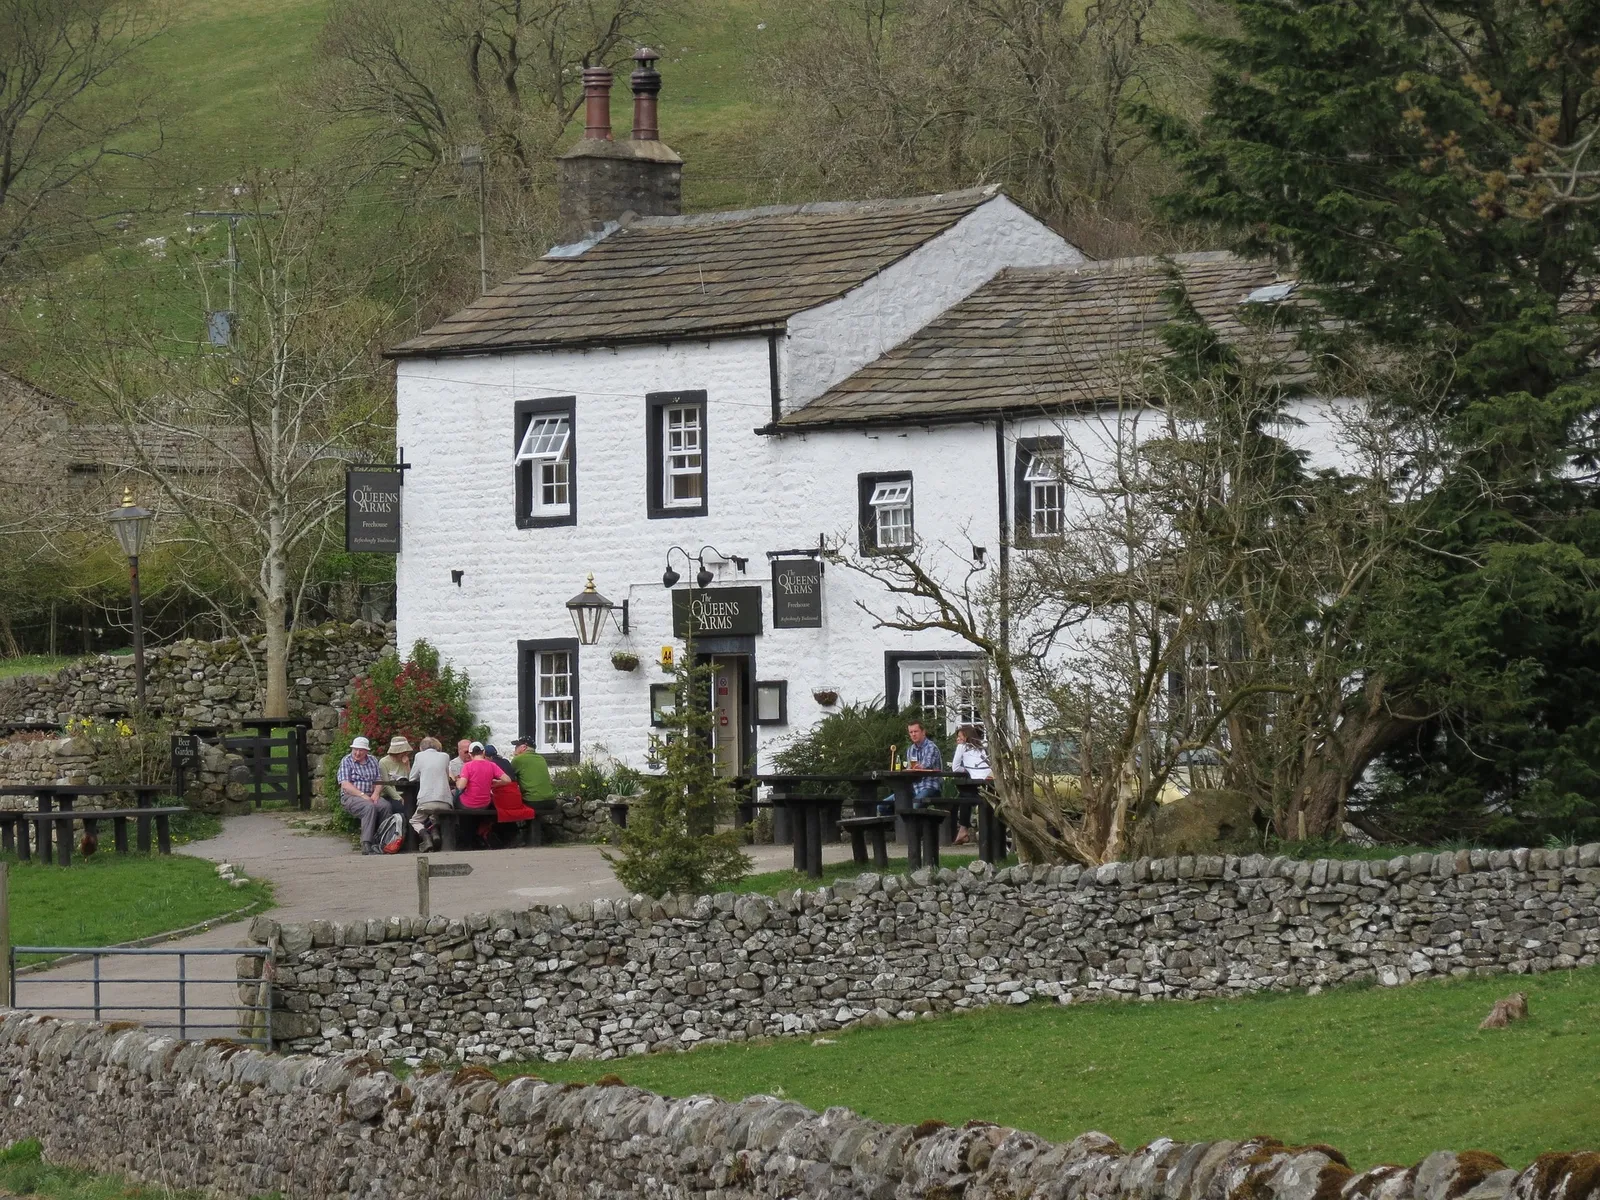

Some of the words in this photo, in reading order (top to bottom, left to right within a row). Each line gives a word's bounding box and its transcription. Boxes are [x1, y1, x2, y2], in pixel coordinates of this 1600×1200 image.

[352, 489, 398, 507] QUEENS
[359, 499, 391, 513] ARMS
[778, 574, 819, 590] QUEENS
[784, 582, 813, 594] ARMS
[701, 593, 712, 602] The
[692, 600, 739, 623] QUEENS
[699, 614, 732, 630] ARMS
[663, 650, 672, 660] AA
[178, 737, 190, 746] Beer
[174, 747, 194, 756] Garden
